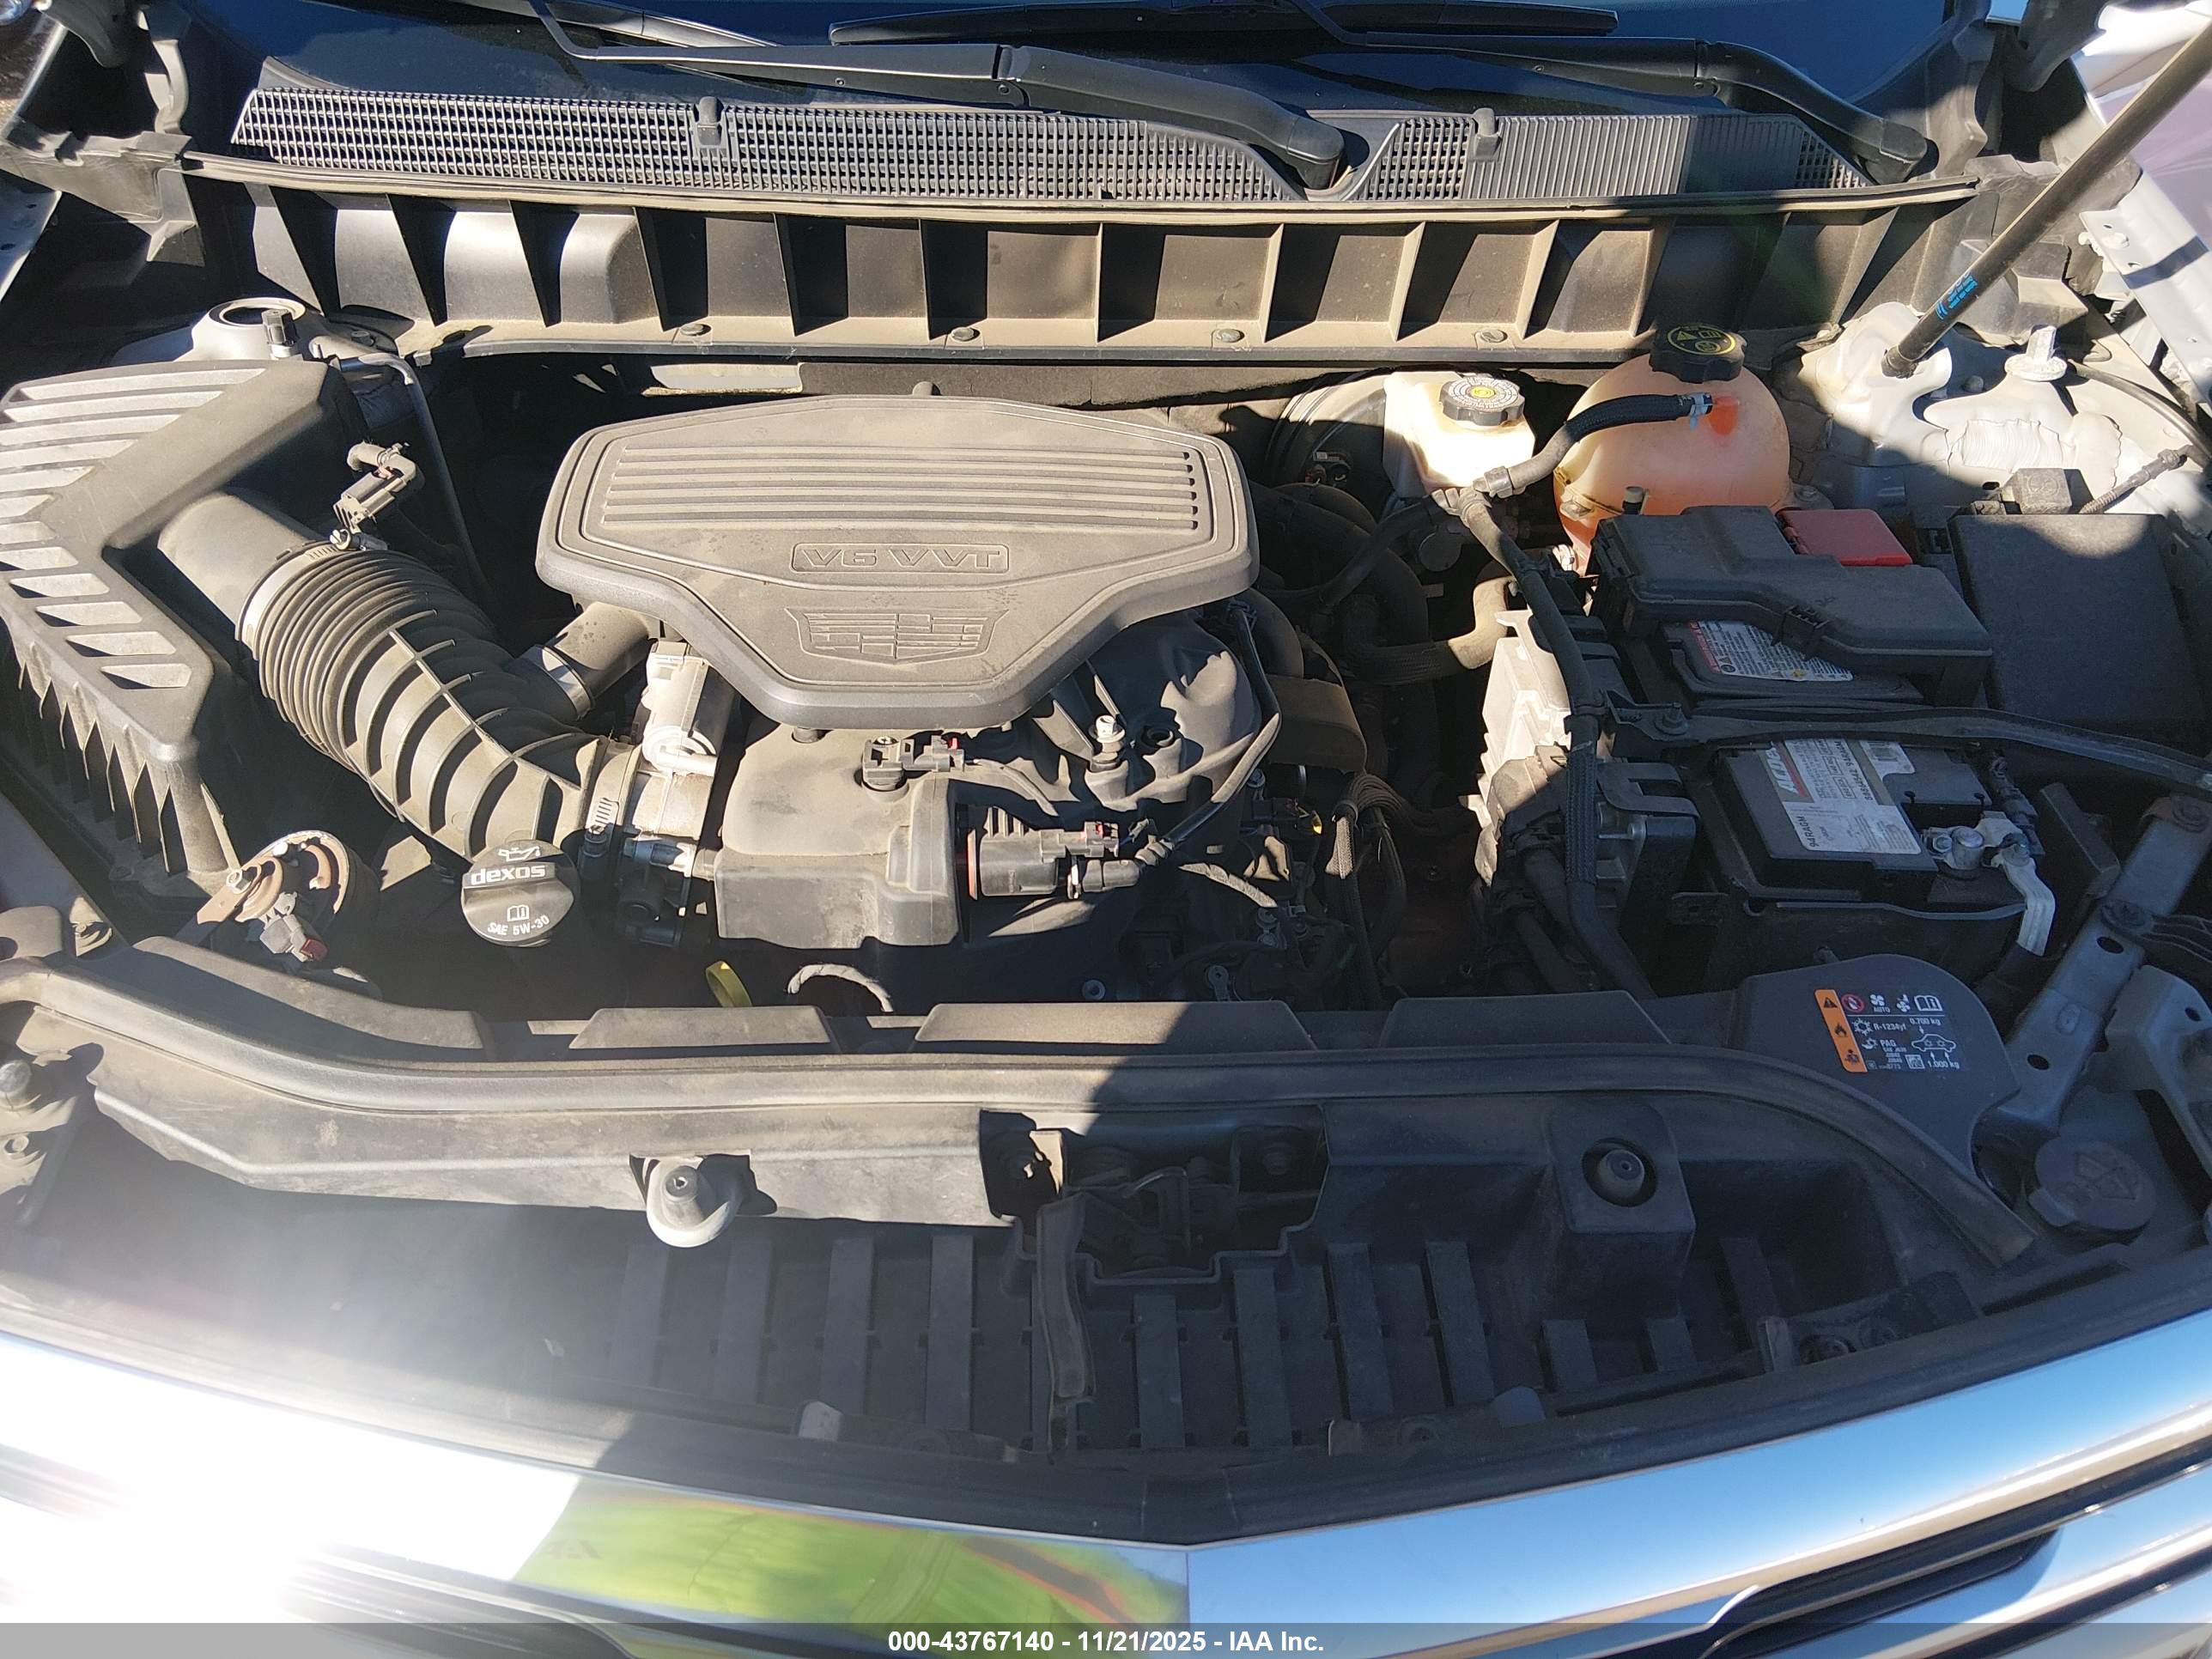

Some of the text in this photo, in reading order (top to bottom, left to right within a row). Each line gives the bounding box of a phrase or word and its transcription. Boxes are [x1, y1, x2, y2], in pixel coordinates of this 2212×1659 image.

[803, 549, 1000, 568] V6 VVT
[1796, 816, 1820, 847] 94RAGM
[471, 865, 546, 885] dexos
[487, 915, 550, 936] SAE 5W-30
[1873, 1023, 1907, 1031] R-1234yf
[1930, 1018, 1941, 1026] kg
[1927, 1060, 1960, 1069] 1.000 kg
